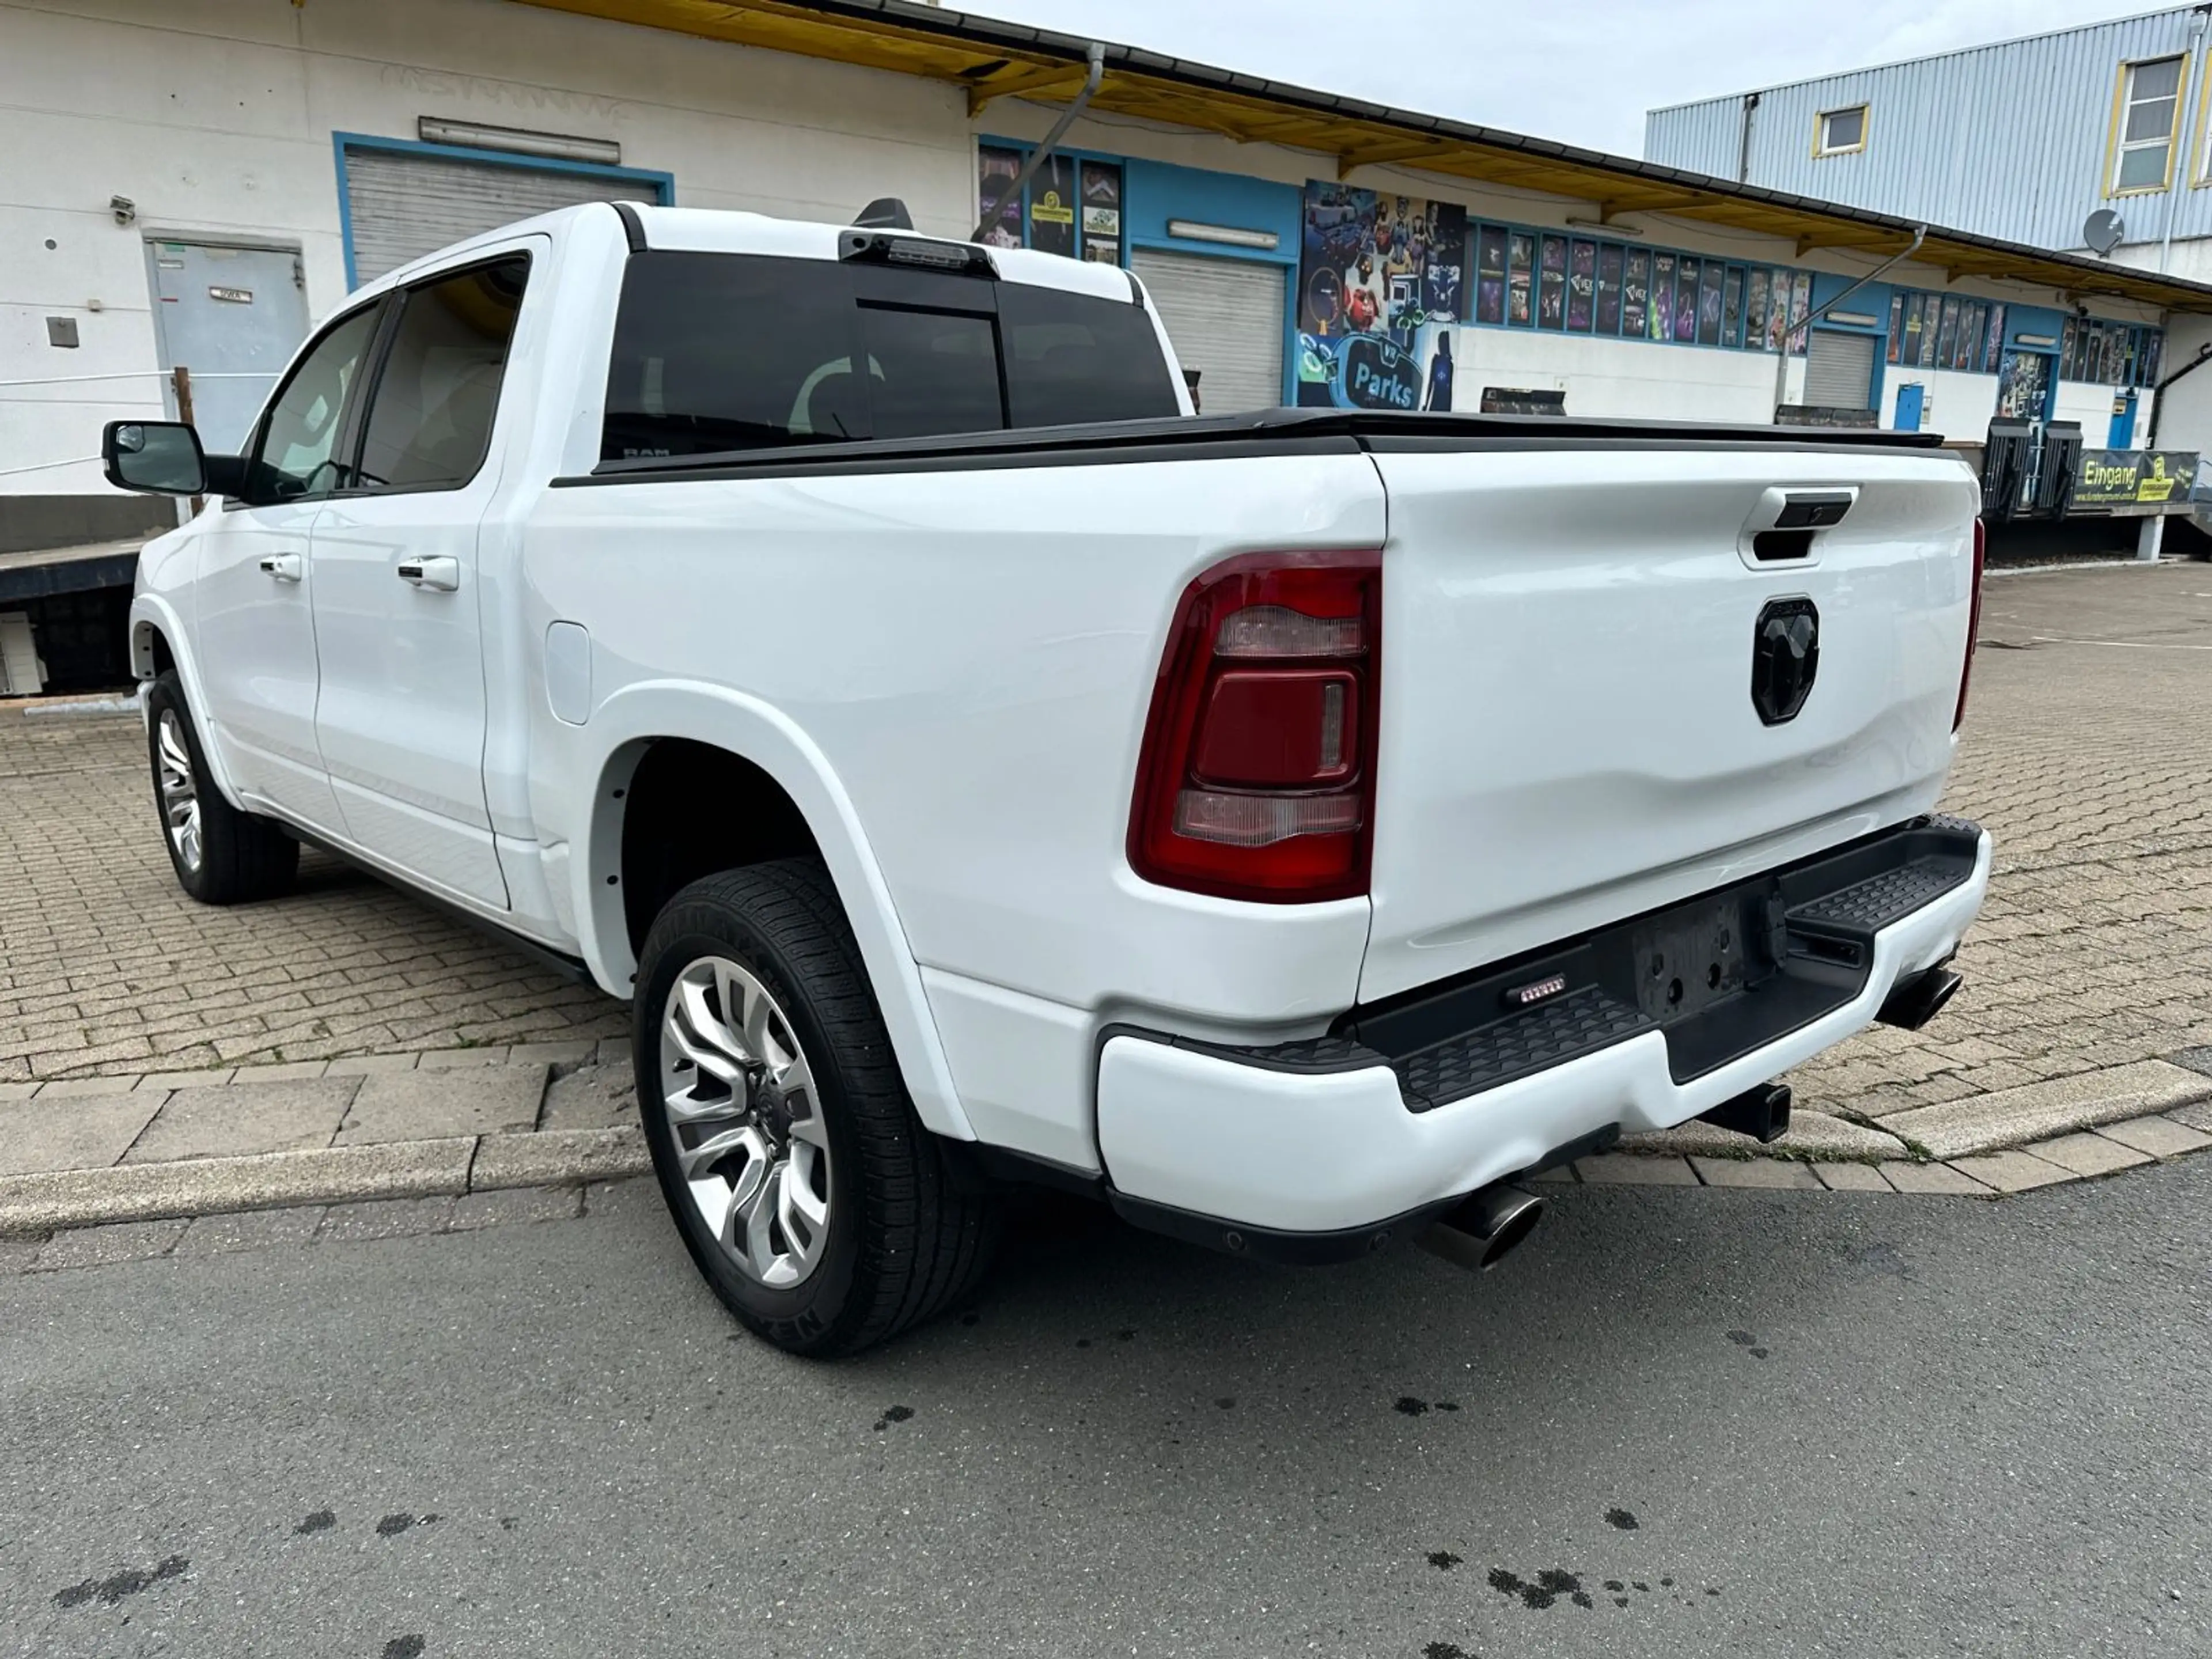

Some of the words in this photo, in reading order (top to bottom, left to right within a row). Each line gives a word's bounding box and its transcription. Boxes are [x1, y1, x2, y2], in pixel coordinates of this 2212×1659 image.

[1384, 343, 1397, 360] VR
[1354, 362, 1412, 408] Parks
[2085, 460, 2137, 490] Eingang
